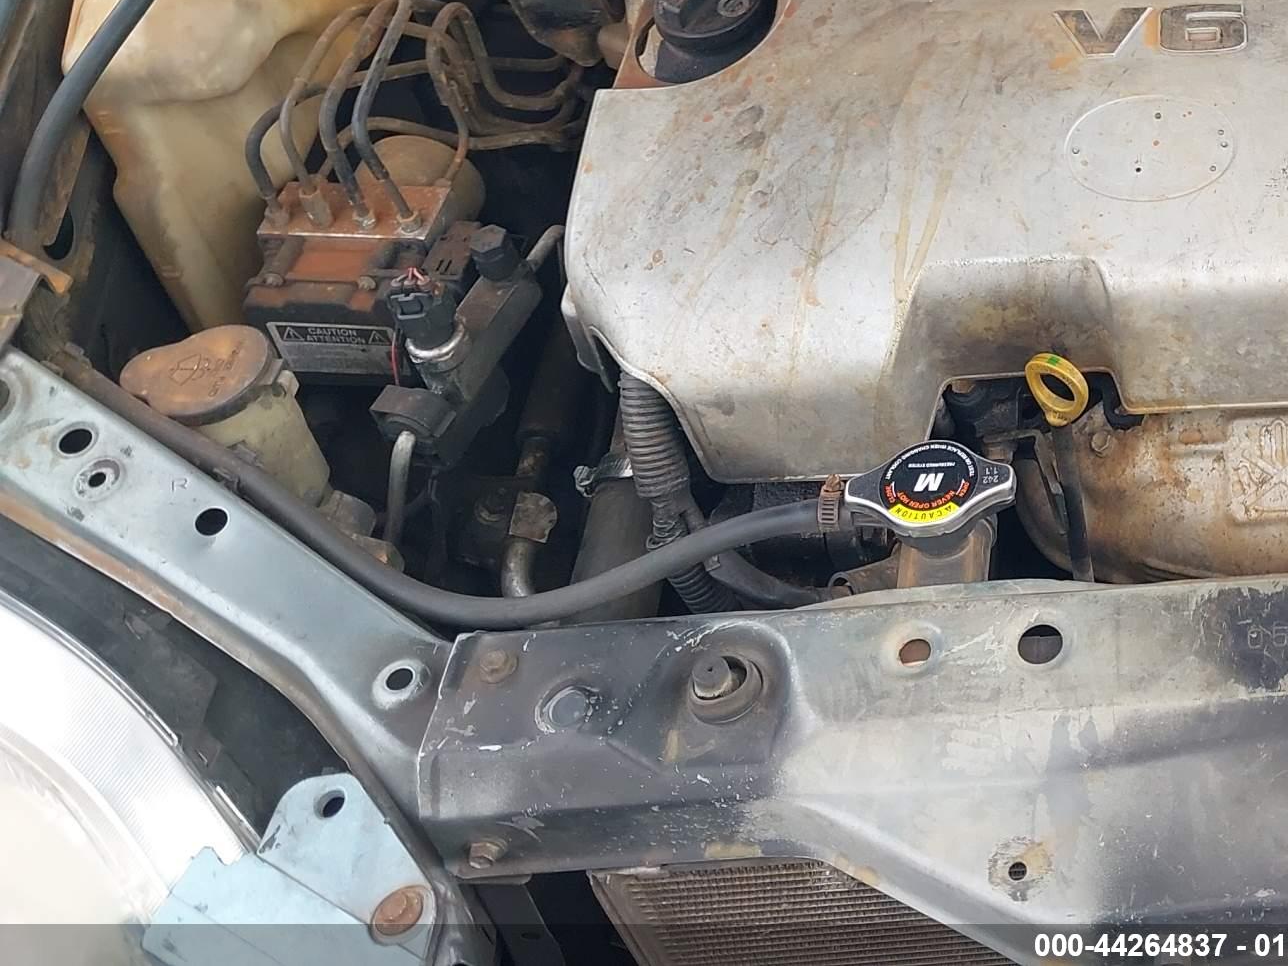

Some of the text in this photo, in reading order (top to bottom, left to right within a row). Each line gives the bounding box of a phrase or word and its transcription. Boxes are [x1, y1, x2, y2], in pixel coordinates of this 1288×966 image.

[1053, 3, 1249, 59] V6
[307, 328, 357, 337] CAUTION
[306, 335, 365, 345] ATTENTION
[984, 466, 999, 475] 1.1
[913, 472, 945, 492] M
[982, 475, 999, 484] 242
[896, 489, 955, 509] NEVER OPEN HOT
[894, 506, 943, 521] CAUTION
